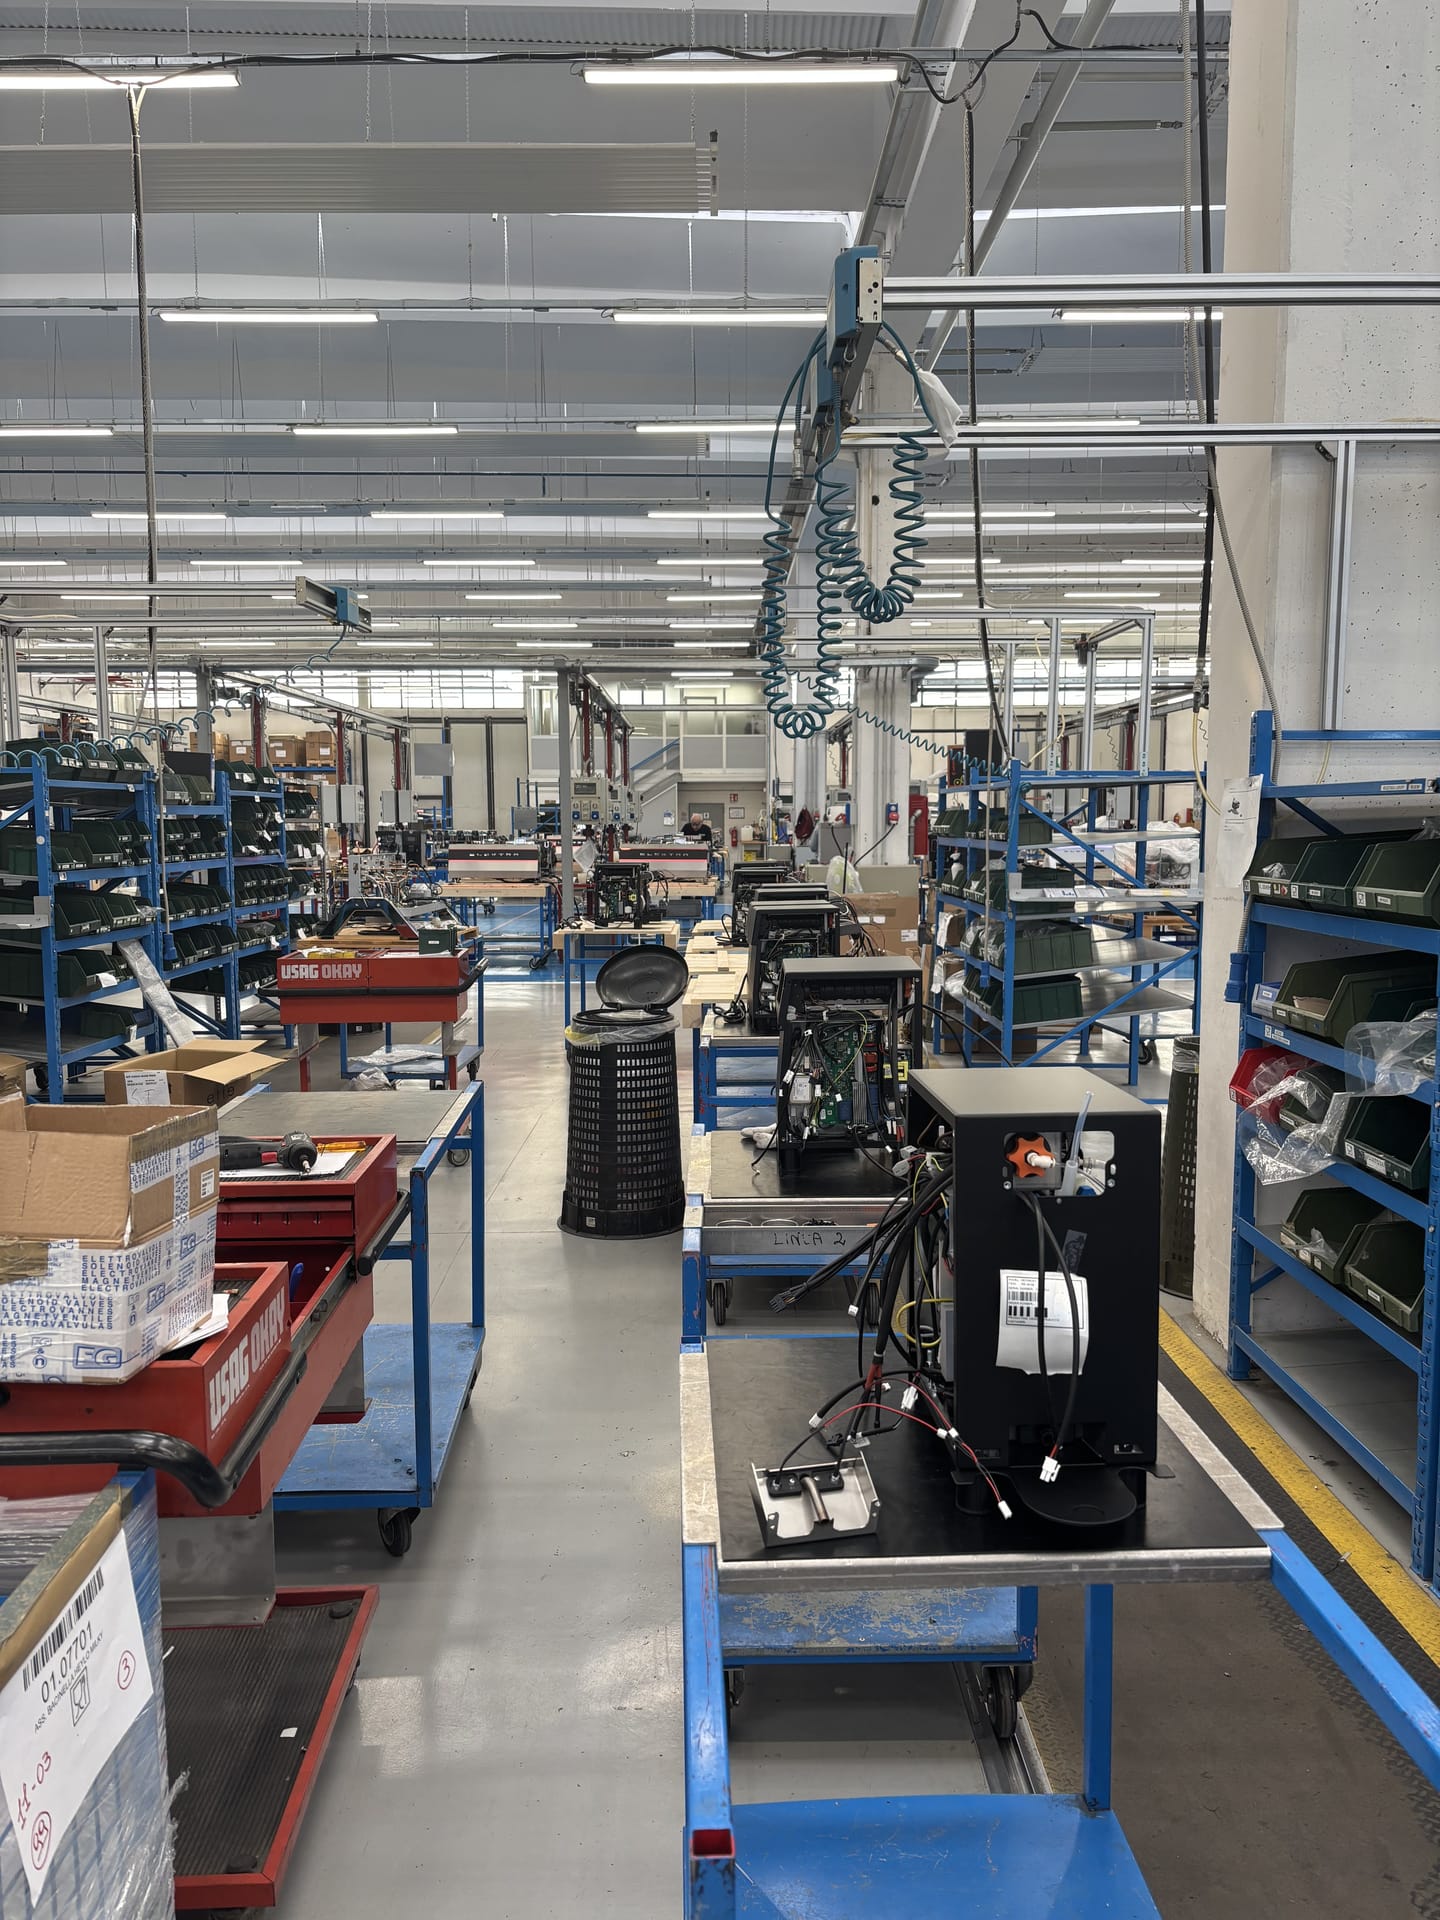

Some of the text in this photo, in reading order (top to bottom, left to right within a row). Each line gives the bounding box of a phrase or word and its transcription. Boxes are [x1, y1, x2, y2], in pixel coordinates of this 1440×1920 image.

[281, 963, 362, 979] USAG OKAY
[833, 1231, 847, 1247] 2
[209, 1286, 285, 1431] USAG OKAY
[41, 1620, 92, 1703] 01.07701
[121, 1657, 131, 1683] 3
[18, 1751, 52, 1830] 11-03
